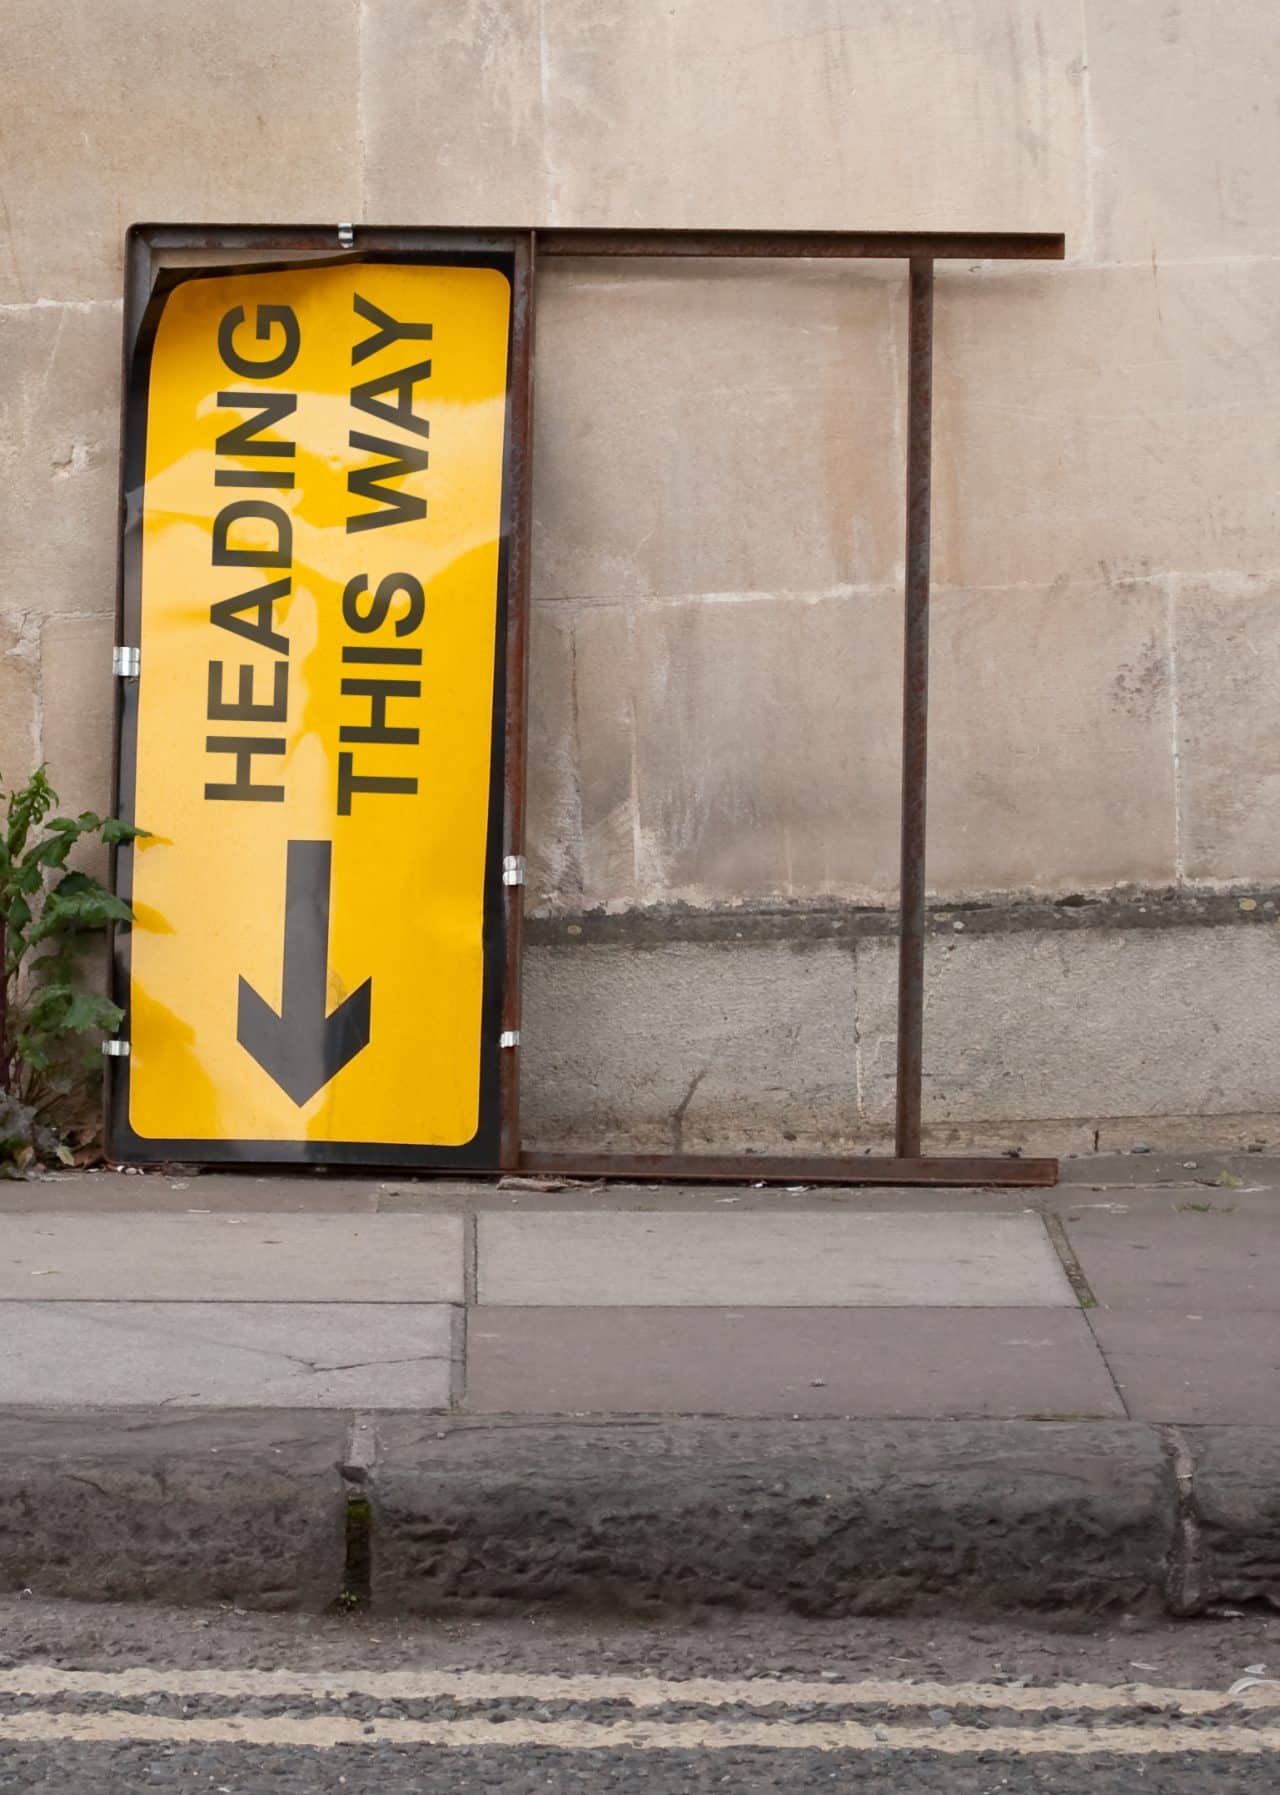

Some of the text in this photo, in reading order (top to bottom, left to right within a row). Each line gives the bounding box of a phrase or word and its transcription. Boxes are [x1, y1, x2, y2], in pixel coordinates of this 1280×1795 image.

[204, 303, 301, 802] HEADING
[337, 292, 433, 816] THIS WAY
